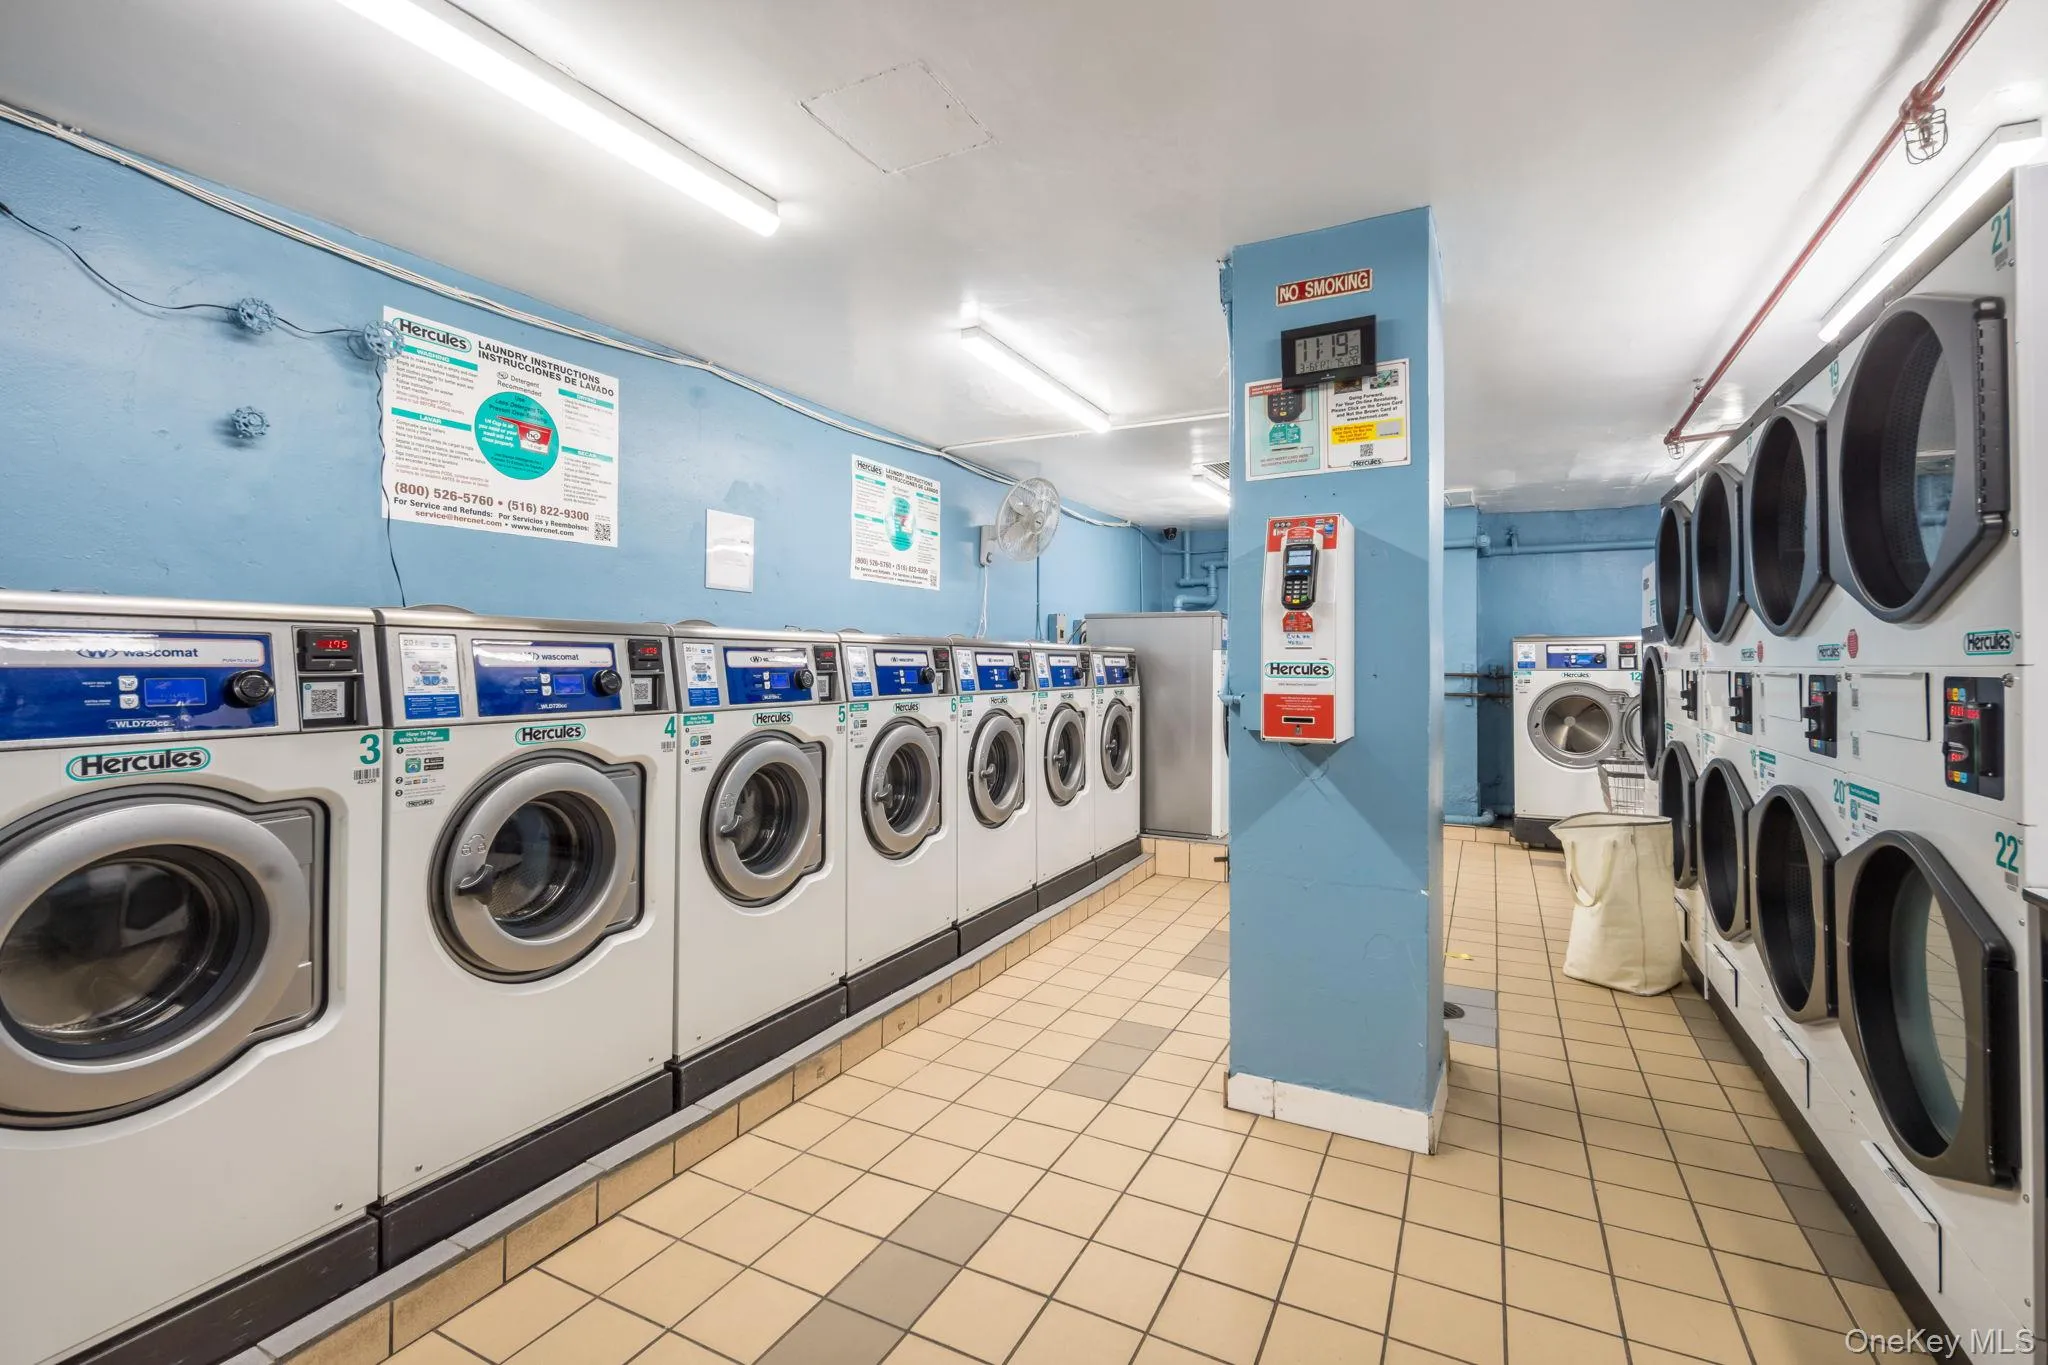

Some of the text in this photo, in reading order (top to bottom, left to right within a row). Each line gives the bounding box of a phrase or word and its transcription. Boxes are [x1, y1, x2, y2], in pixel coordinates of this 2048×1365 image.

[1991, 207, 2011, 254] 21
[1280, 271, 1368, 302] NO SMOKING
[400, 319, 467, 350] Hercules
[416, 348, 450, 362] WASHING
[1304, 332, 1349, 362] 11:19
[478, 341, 600, 385] LAUNDRY INSTRUCTIONS
[478, 350, 561, 382] INSTRUCCIONES
[565, 375, 577, 386] DE
[580, 378, 614, 397] LAVADO
[511, 375, 540, 388] Detergent
[1829, 360, 1839, 388] 19
[497, 380, 542, 397] Recommended
[420, 414, 442, 425] LAVAR
[857, 460, 882, 474] Hercules
[1353, 458, 1381, 468] Hercules
[394, 481, 430, 499] (800)
[433, 487, 494, 507] 526-5760
[507, 500, 537, 515] (516)
[540, 505, 590, 521] 822-9300
[393, 496, 407, 505] For
[410, 499, 441, 510] Service
[442, 504, 458, 513] and
[460, 506, 493, 518] Refunds:
[498, 512, 510, 520] Por
[512, 514, 543, 525] Servicios
[550, 520, 590, 532] Reembolsos:
[415, 510, 575, 537] service@hercnet.com www.hercnet.com
[1967, 632, 2010, 651] Hercules
[541, 653, 579, 661] wascomat
[1270, 663, 1329, 676] Hercules
[1630, 672, 1641, 681] 12
[838, 705, 846, 723] 5
[895, 703, 919, 712] Hercules
[951, 698, 957, 712] 6
[664, 715, 676, 738] 4
[756, 712, 791, 724] Hercules
[521, 725, 582, 741] Hercules
[359, 733, 381, 765] 3
[81, 750, 201, 776] Hercules
[1833, 779, 1845, 804] 20
[1995, 831, 2019, 874] 22
